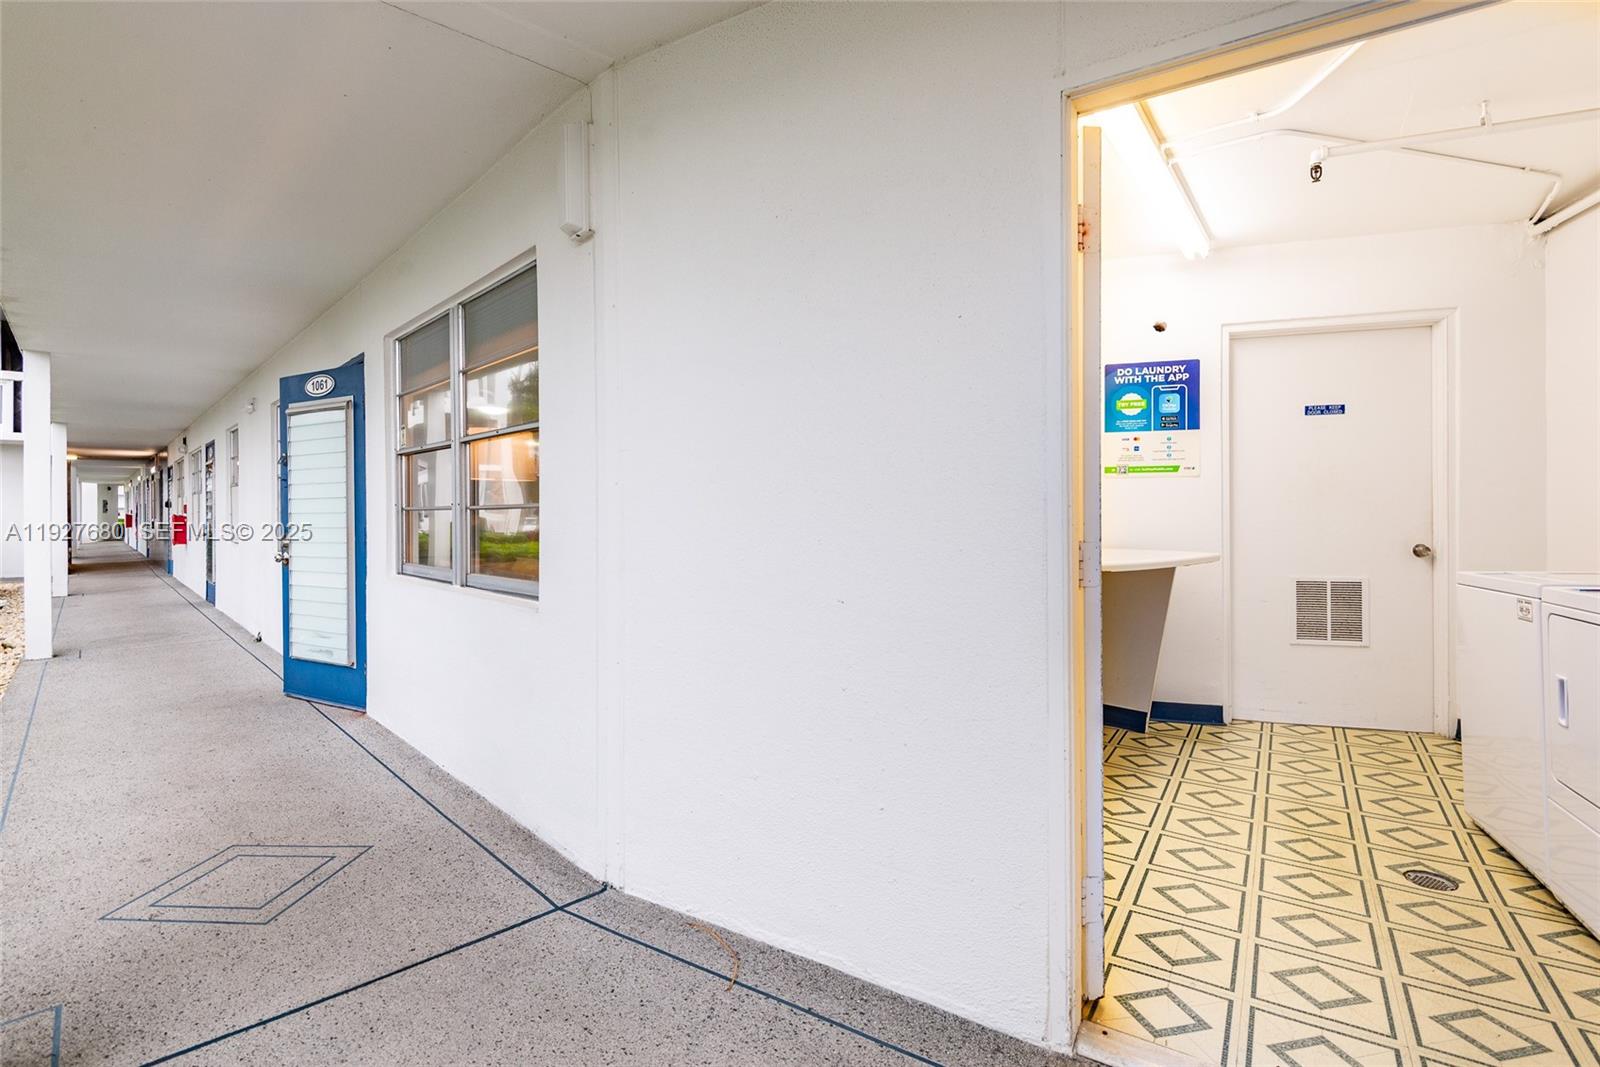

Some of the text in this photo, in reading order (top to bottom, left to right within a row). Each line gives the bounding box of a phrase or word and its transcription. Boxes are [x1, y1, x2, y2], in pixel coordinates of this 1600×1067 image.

[1117, 365, 1187, 376] DO LAUNDRY
[1114, 373, 1190, 384] WITH THE APP
[311, 379, 328, 391] 1061
